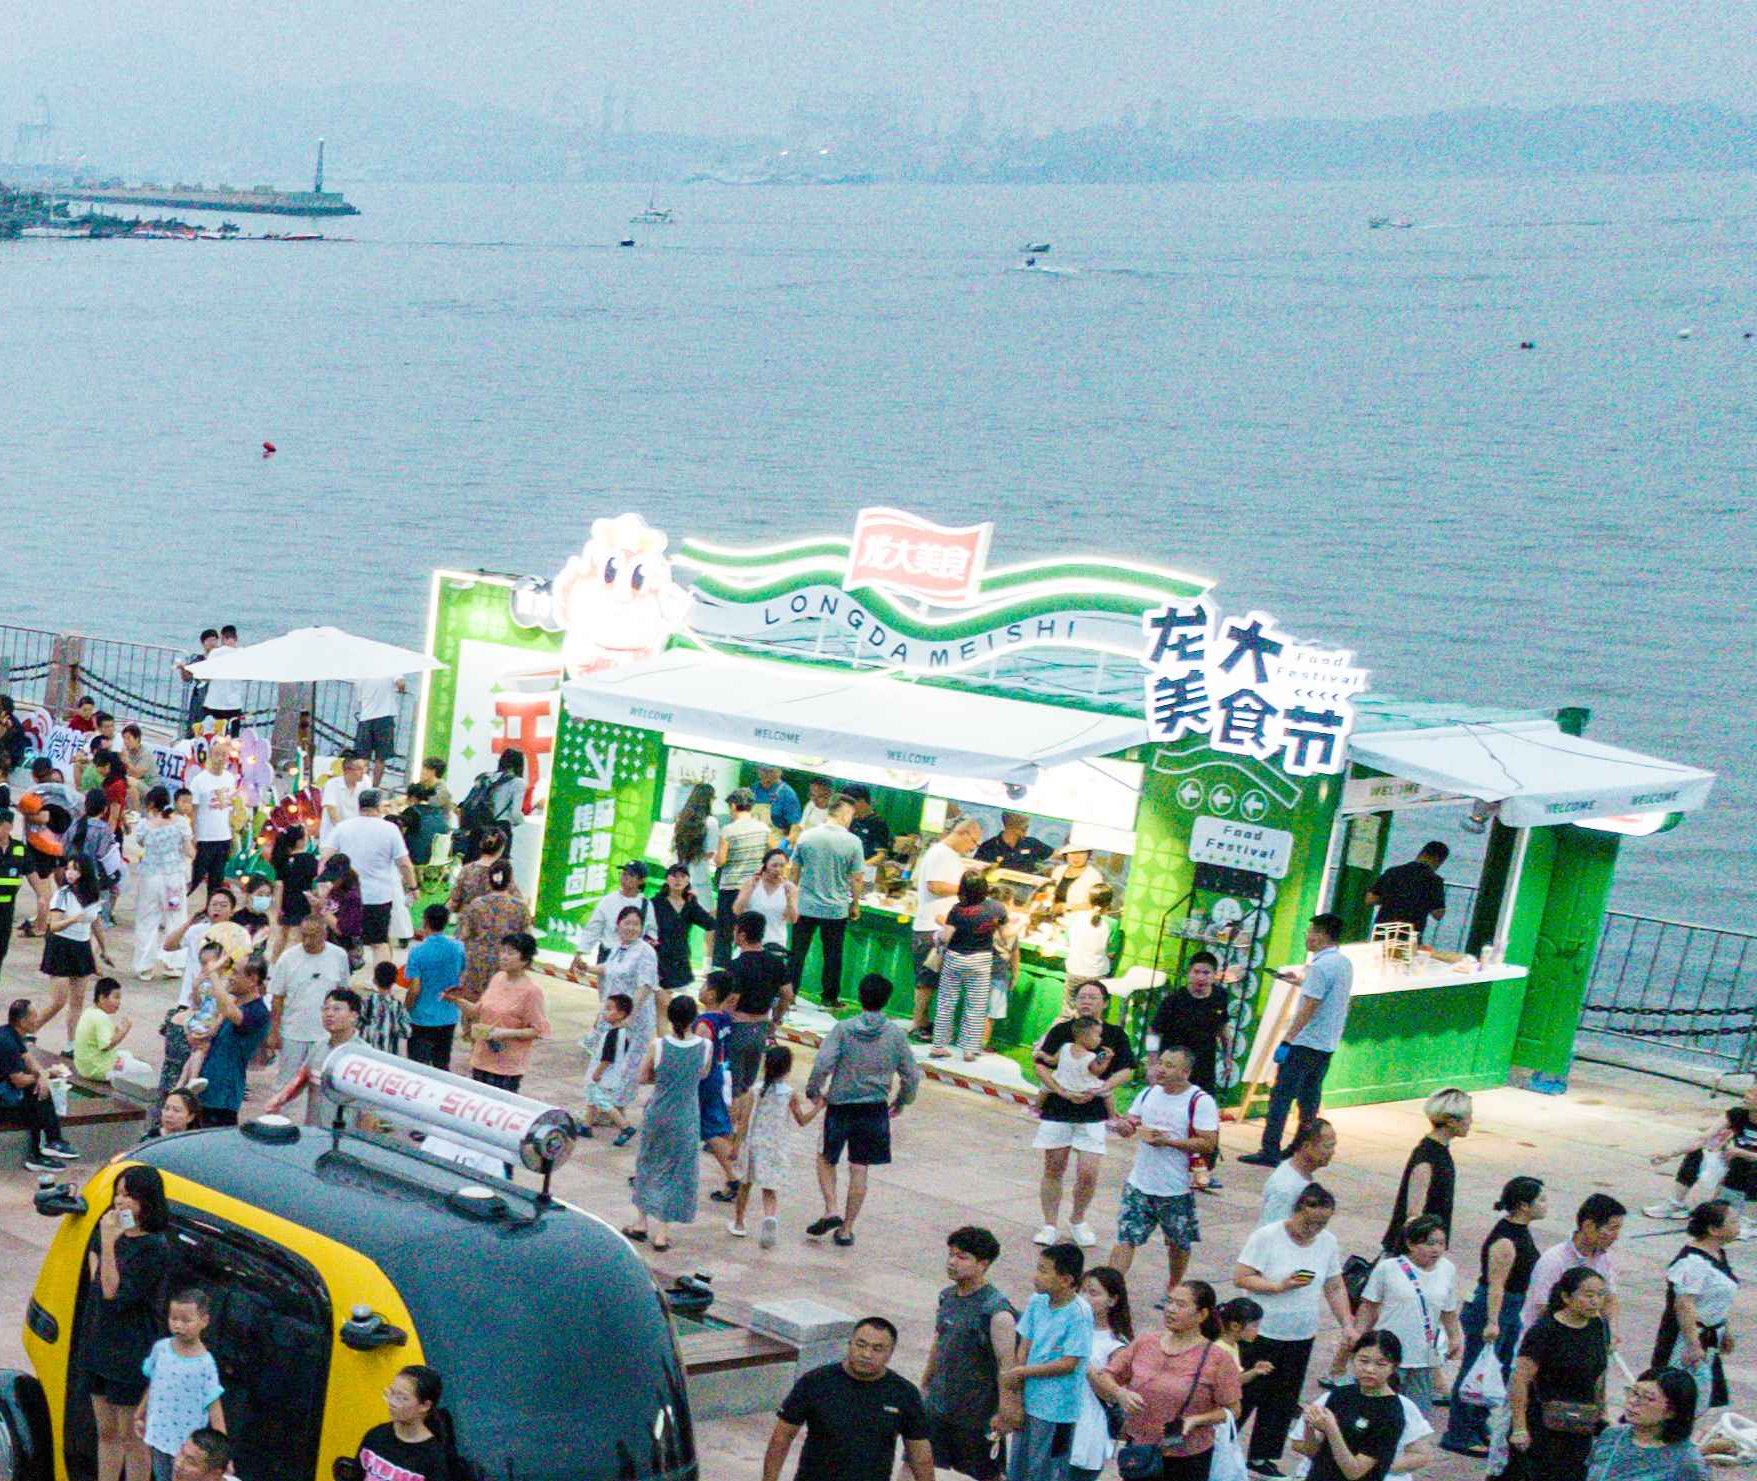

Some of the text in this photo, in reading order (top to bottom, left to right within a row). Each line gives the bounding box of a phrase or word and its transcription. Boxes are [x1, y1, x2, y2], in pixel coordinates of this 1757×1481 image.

[765, 594, 1075, 667] LONGDA MEISHI
[1295, 651, 1344, 668] Food
[1276, 666, 1359, 686] Festival
[629, 706, 674, 724] WELCOME
[1153, 669, 1345, 768] 美食节
[754, 727, 801, 745] WELCOME
[887, 749, 938, 767] WELCOME
[1223, 825, 1264, 842] Food
[1205, 838, 1276, 860] Festival
